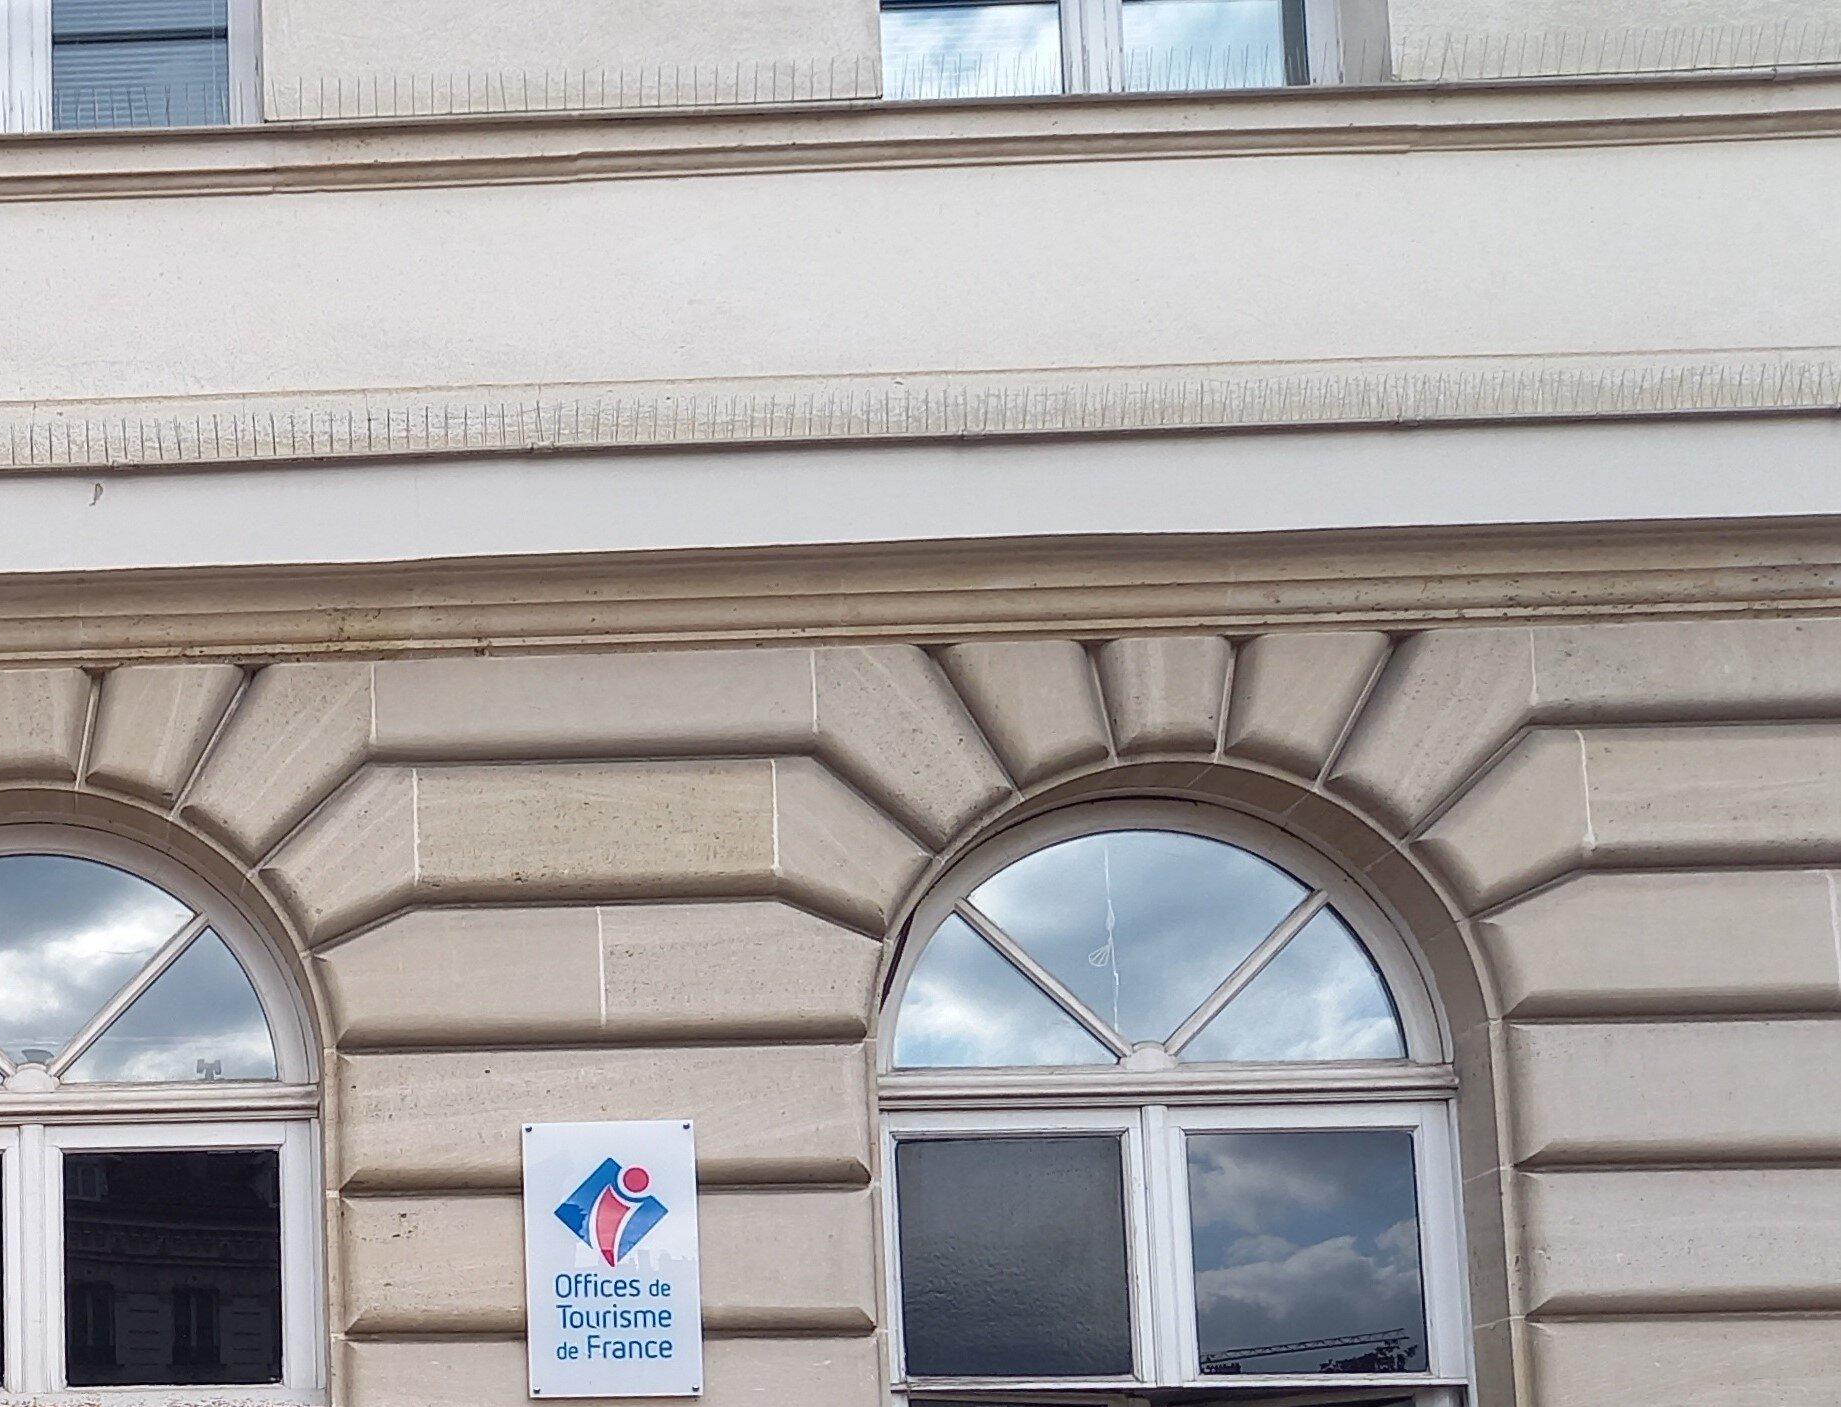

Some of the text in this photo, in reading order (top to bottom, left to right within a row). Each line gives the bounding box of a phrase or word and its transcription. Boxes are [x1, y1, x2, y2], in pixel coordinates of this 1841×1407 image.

[556, 1274, 670, 1298] Offices de
[556, 1304, 671, 1329] Tourisme
[557, 1335, 672, 1360] de France
